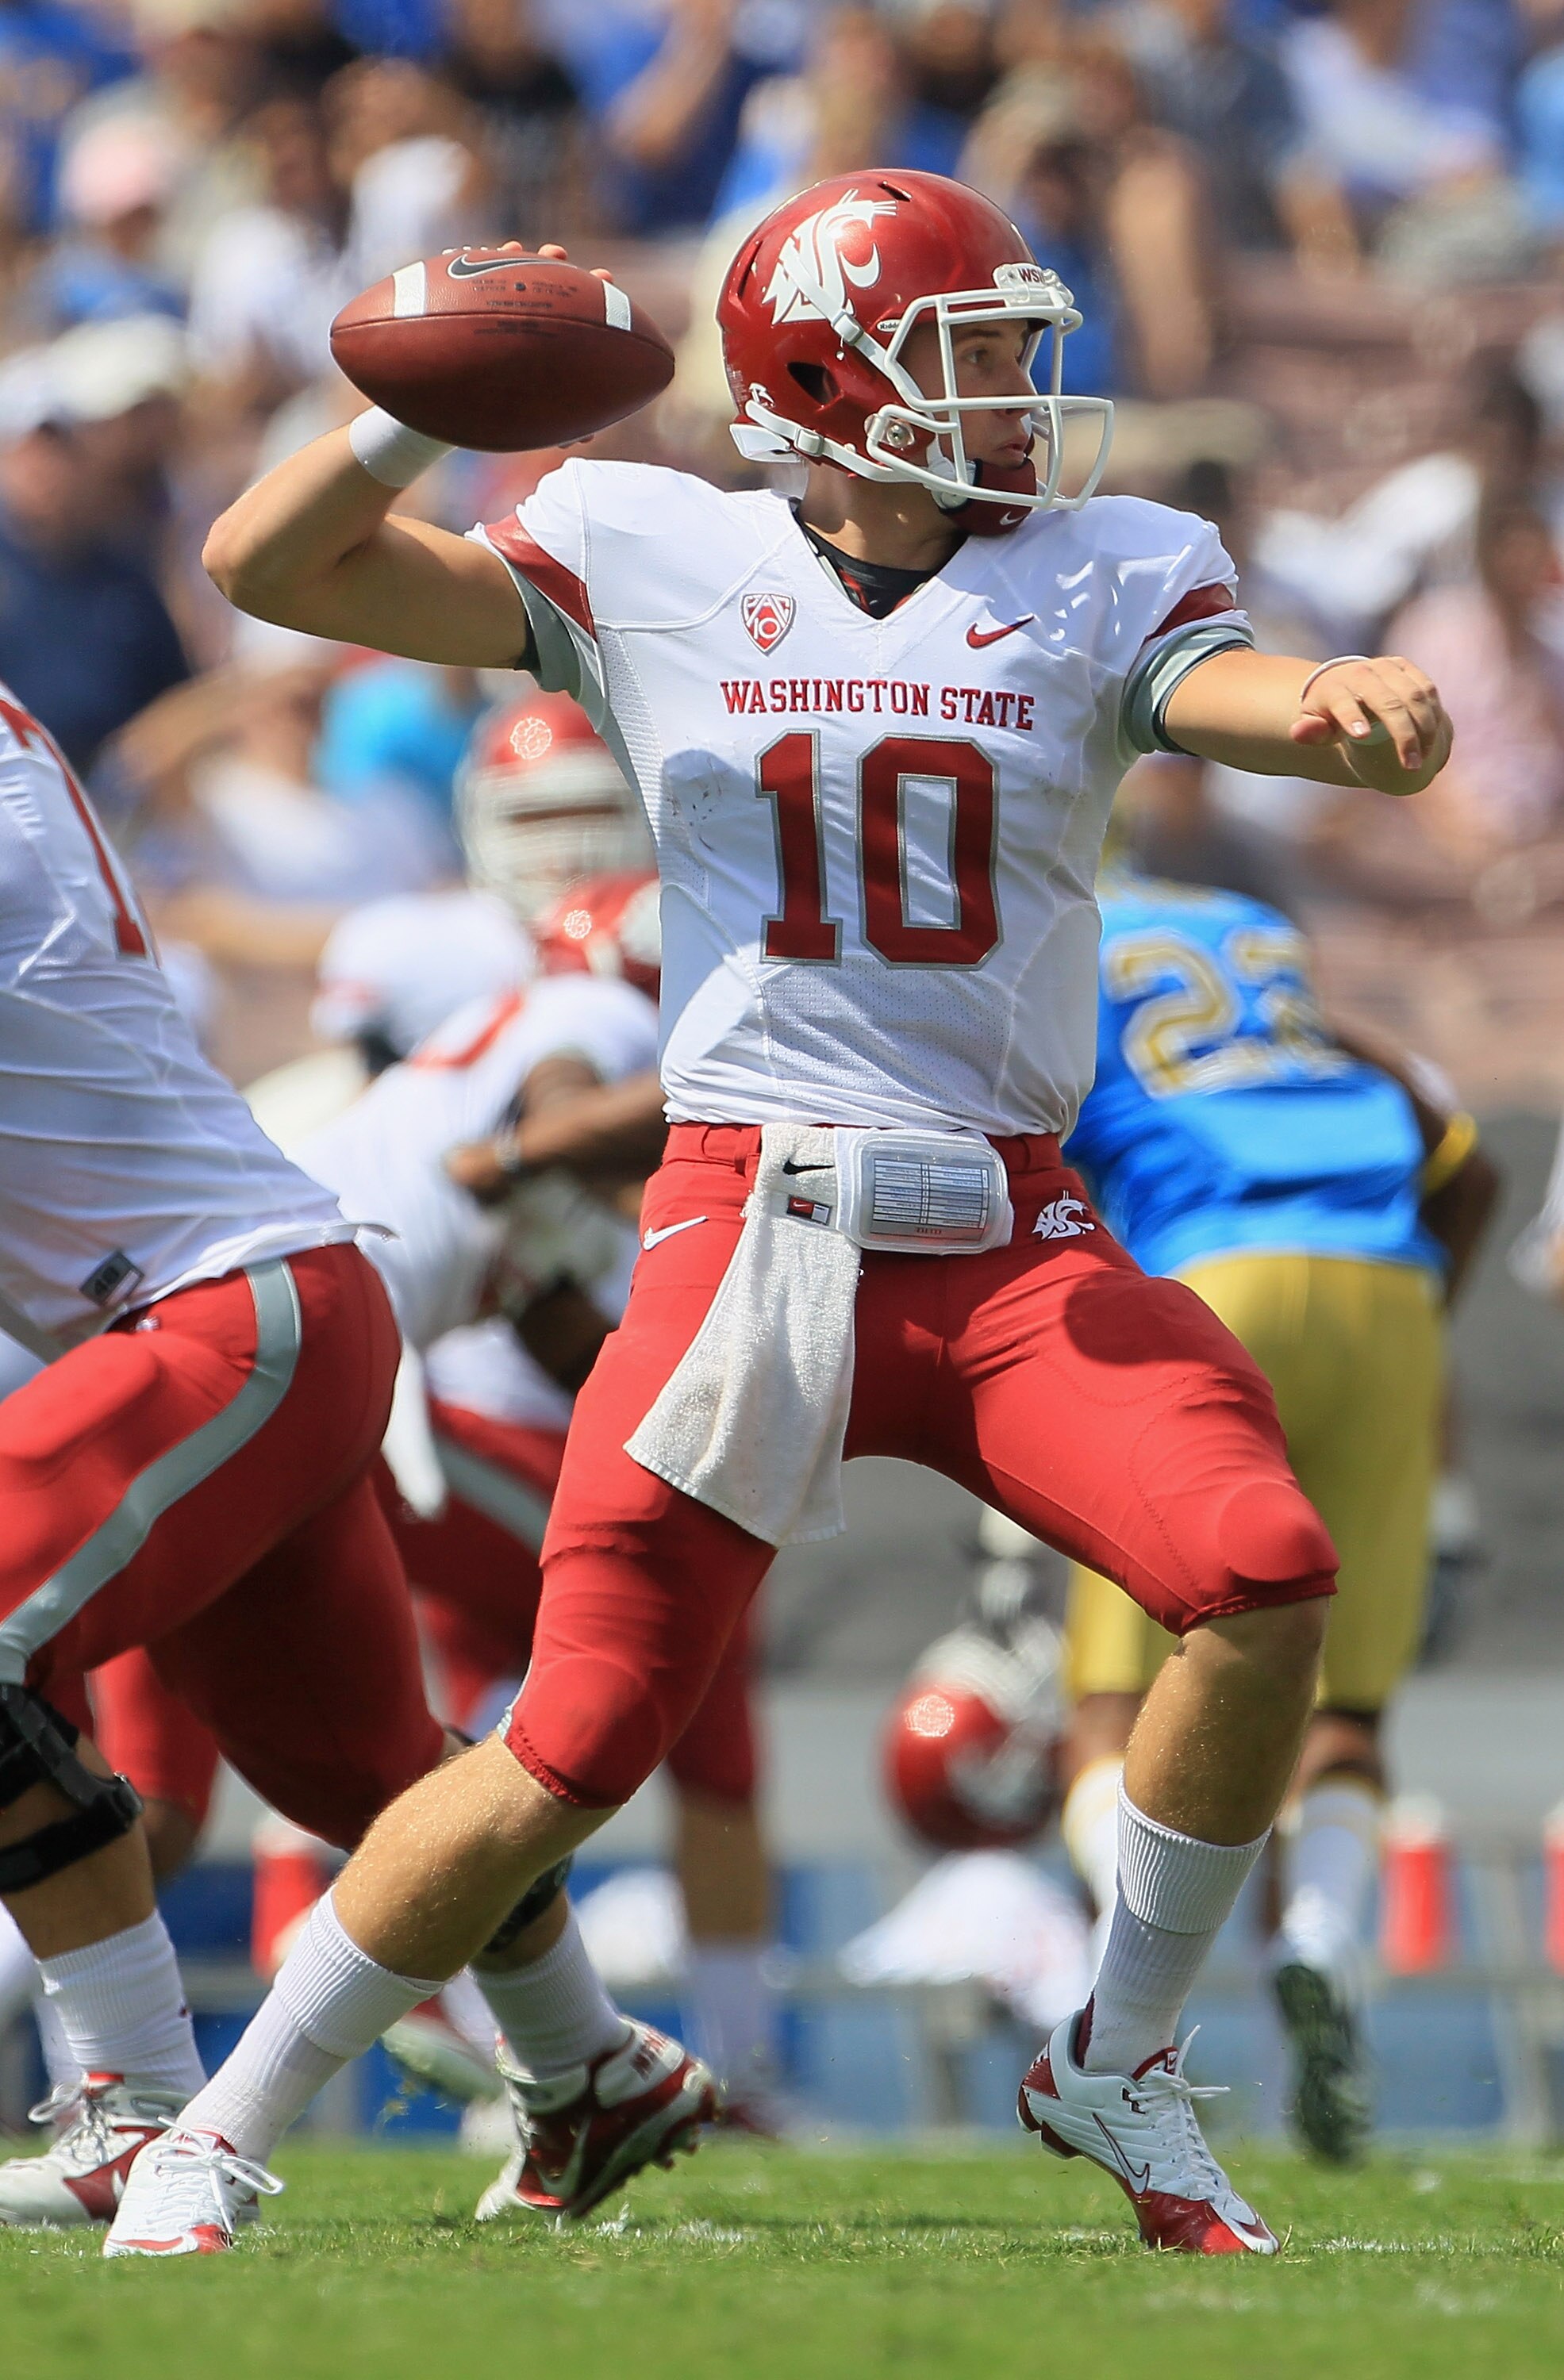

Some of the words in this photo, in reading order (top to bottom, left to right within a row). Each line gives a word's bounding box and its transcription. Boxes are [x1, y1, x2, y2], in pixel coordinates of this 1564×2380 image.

[744, 594, 790, 627] PAC
[753, 616, 782, 639] 10
[720, 678, 930, 716] WASHINGTON
[940, 685, 1035, 731] STATE
[755, 727, 1004, 971] 10
